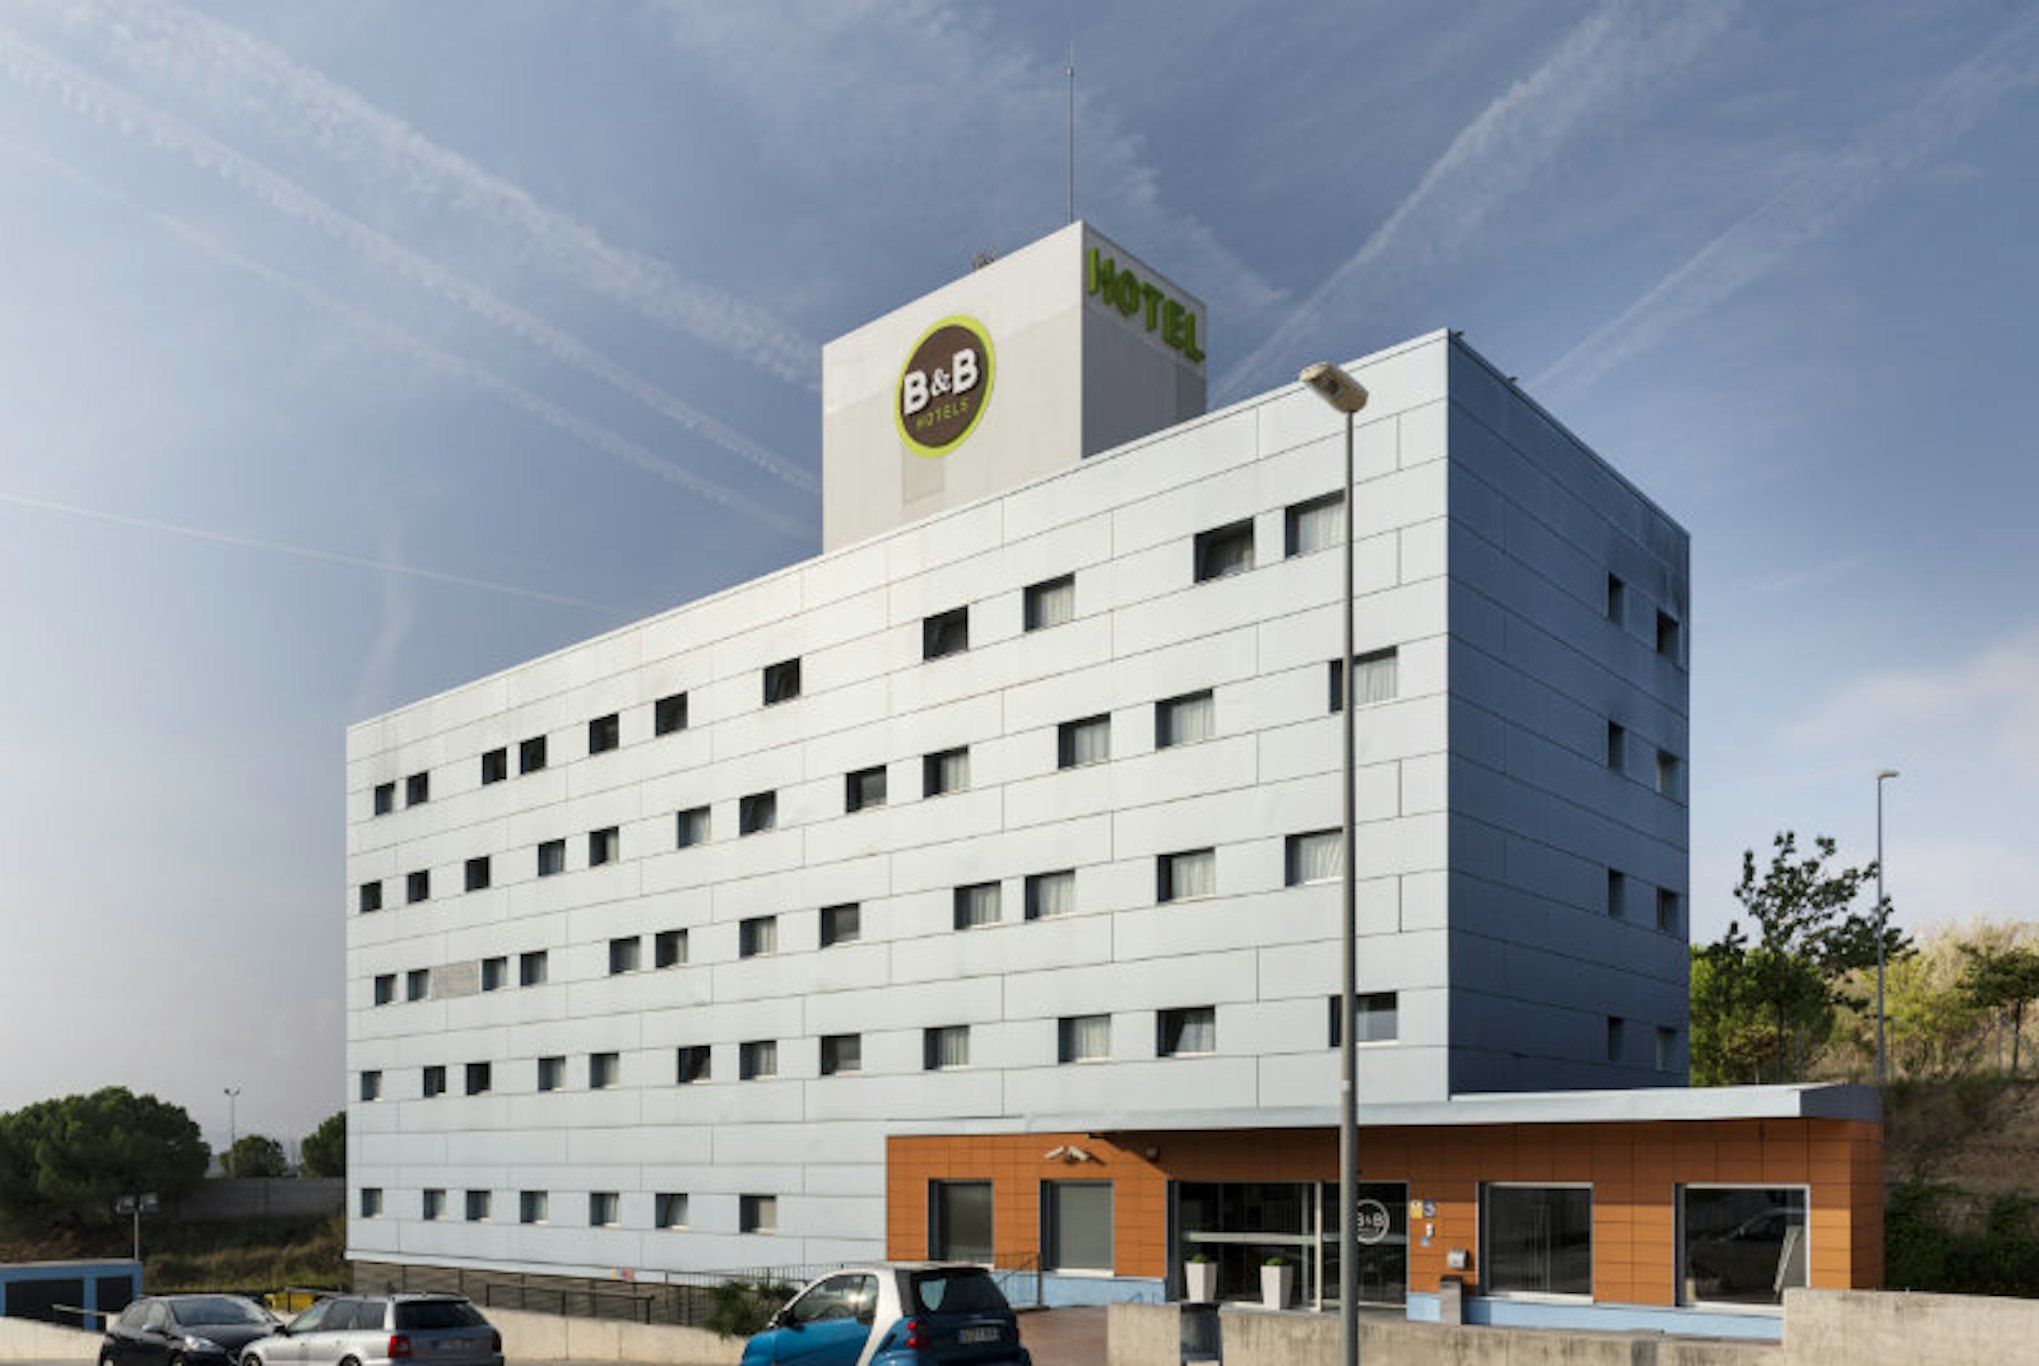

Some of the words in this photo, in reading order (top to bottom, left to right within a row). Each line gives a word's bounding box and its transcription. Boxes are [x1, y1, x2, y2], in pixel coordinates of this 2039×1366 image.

[1088, 246, 1205, 363] HOTEL
[903, 348, 979, 415] B&B
[916, 397, 968, 427] HOTELS
